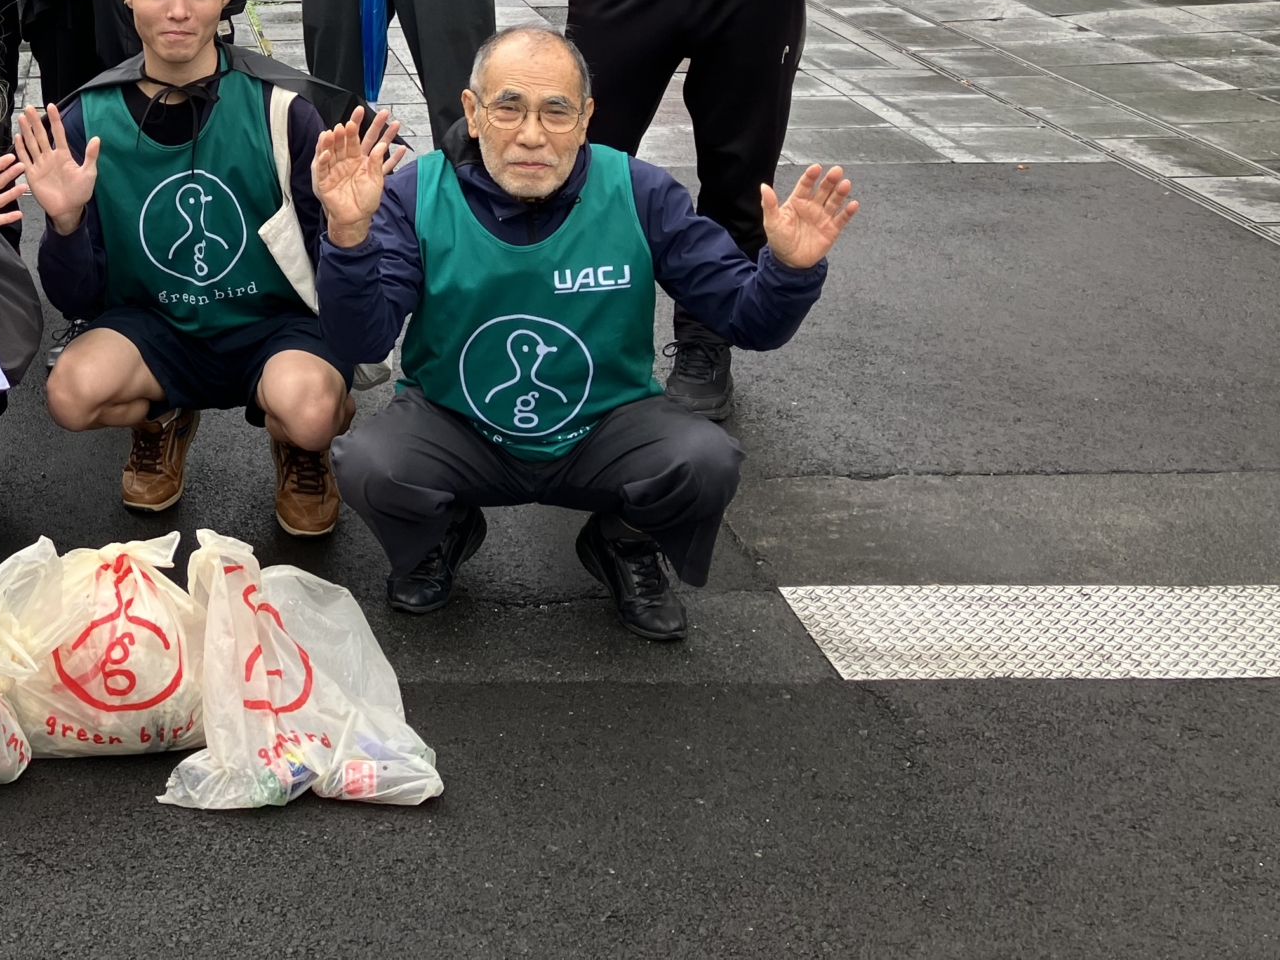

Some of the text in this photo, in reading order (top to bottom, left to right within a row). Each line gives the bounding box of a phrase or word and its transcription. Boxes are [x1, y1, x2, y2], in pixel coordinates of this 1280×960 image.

[158, 281, 259, 305] green bird
[553, 264, 631, 294] UACJ
[45, 715, 123, 745] green
[139, 711, 195, 744] bird
